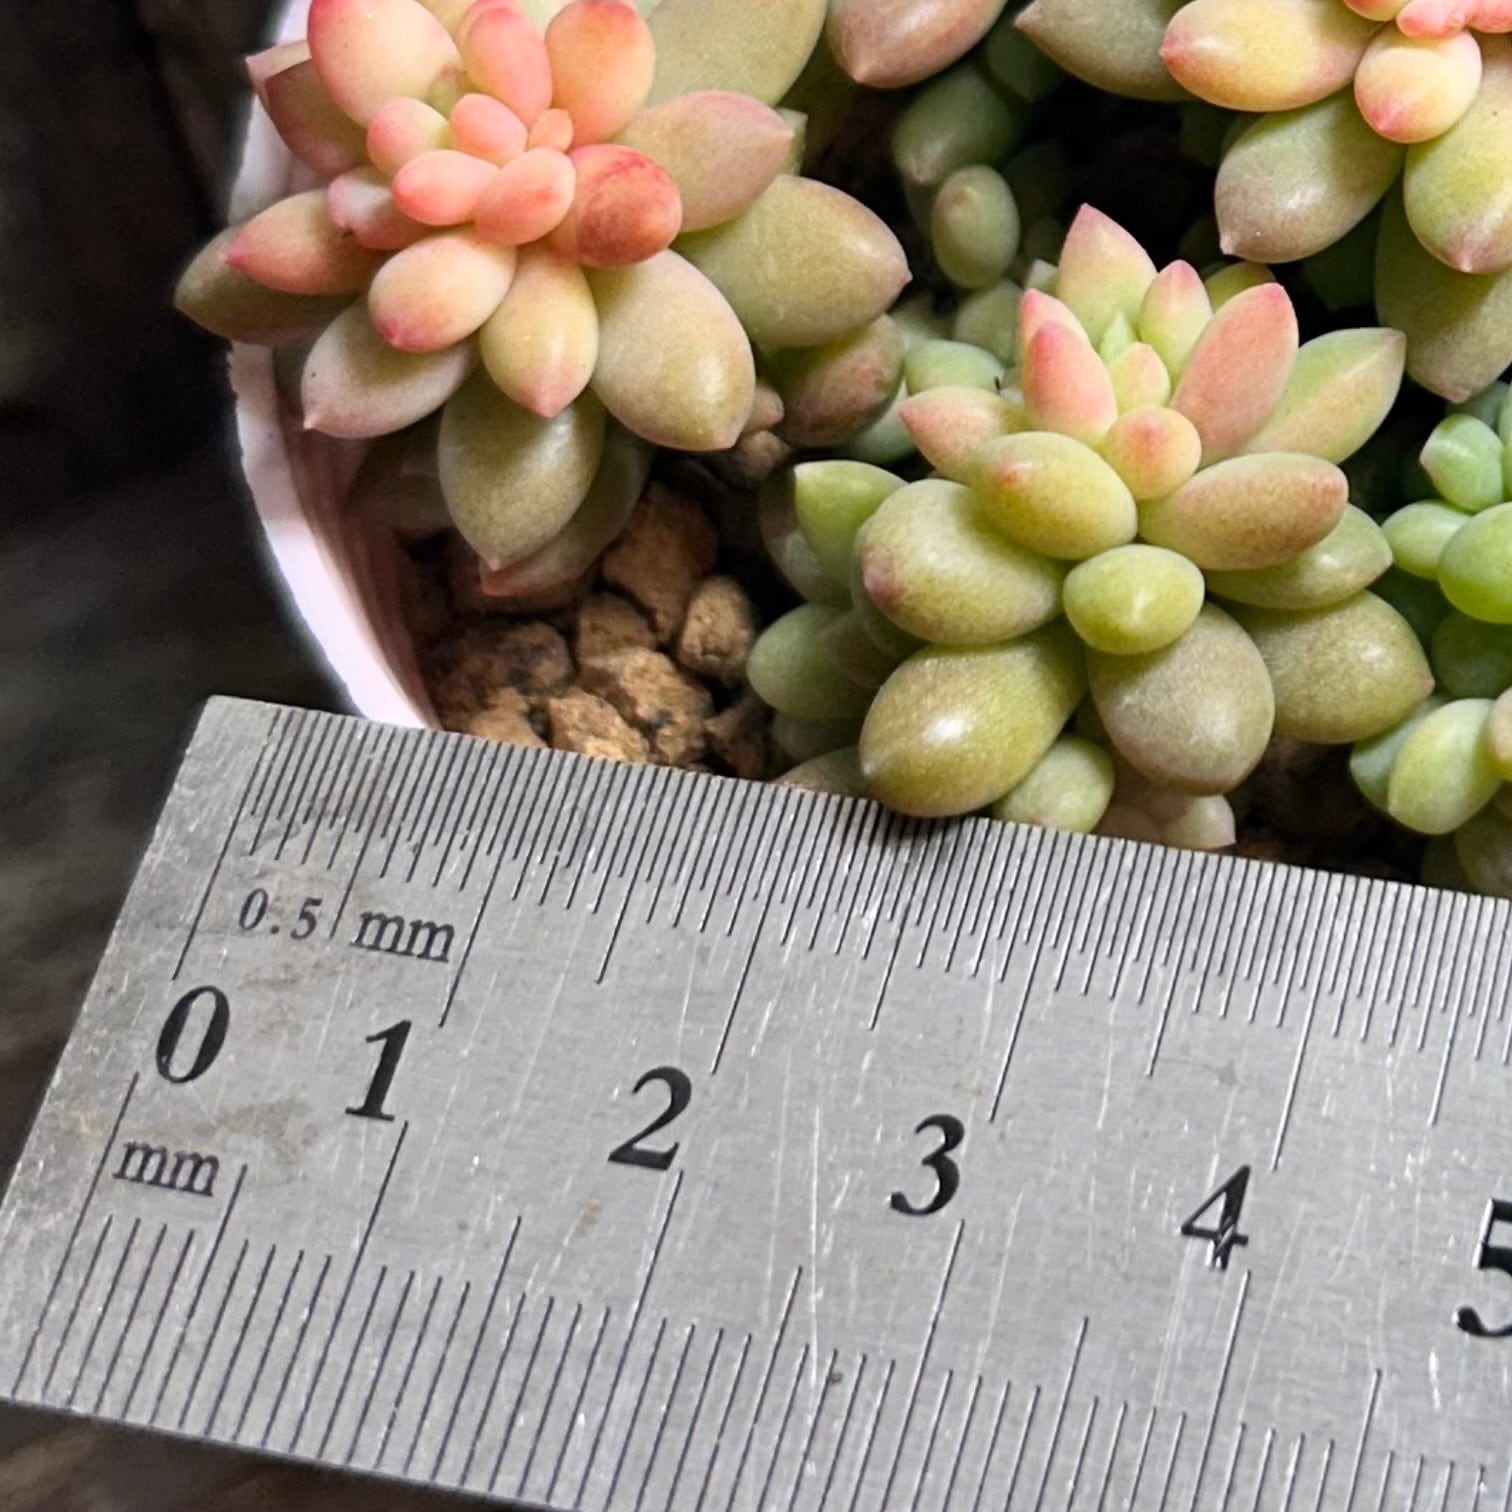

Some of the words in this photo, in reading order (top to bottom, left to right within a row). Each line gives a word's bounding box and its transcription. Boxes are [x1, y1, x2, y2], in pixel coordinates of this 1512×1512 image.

[236, 886, 323, 942] 0.5
[349, 900, 457, 964] mm
[154, 984, 231, 1085] 0
[344, 1019, 415, 1123] 1
[607, 1066, 694, 1173] 2
[889, 1114, 967, 1218] 3
[1179, 1164, 1252, 1272] 4
[113, 1138, 224, 1199] mm
